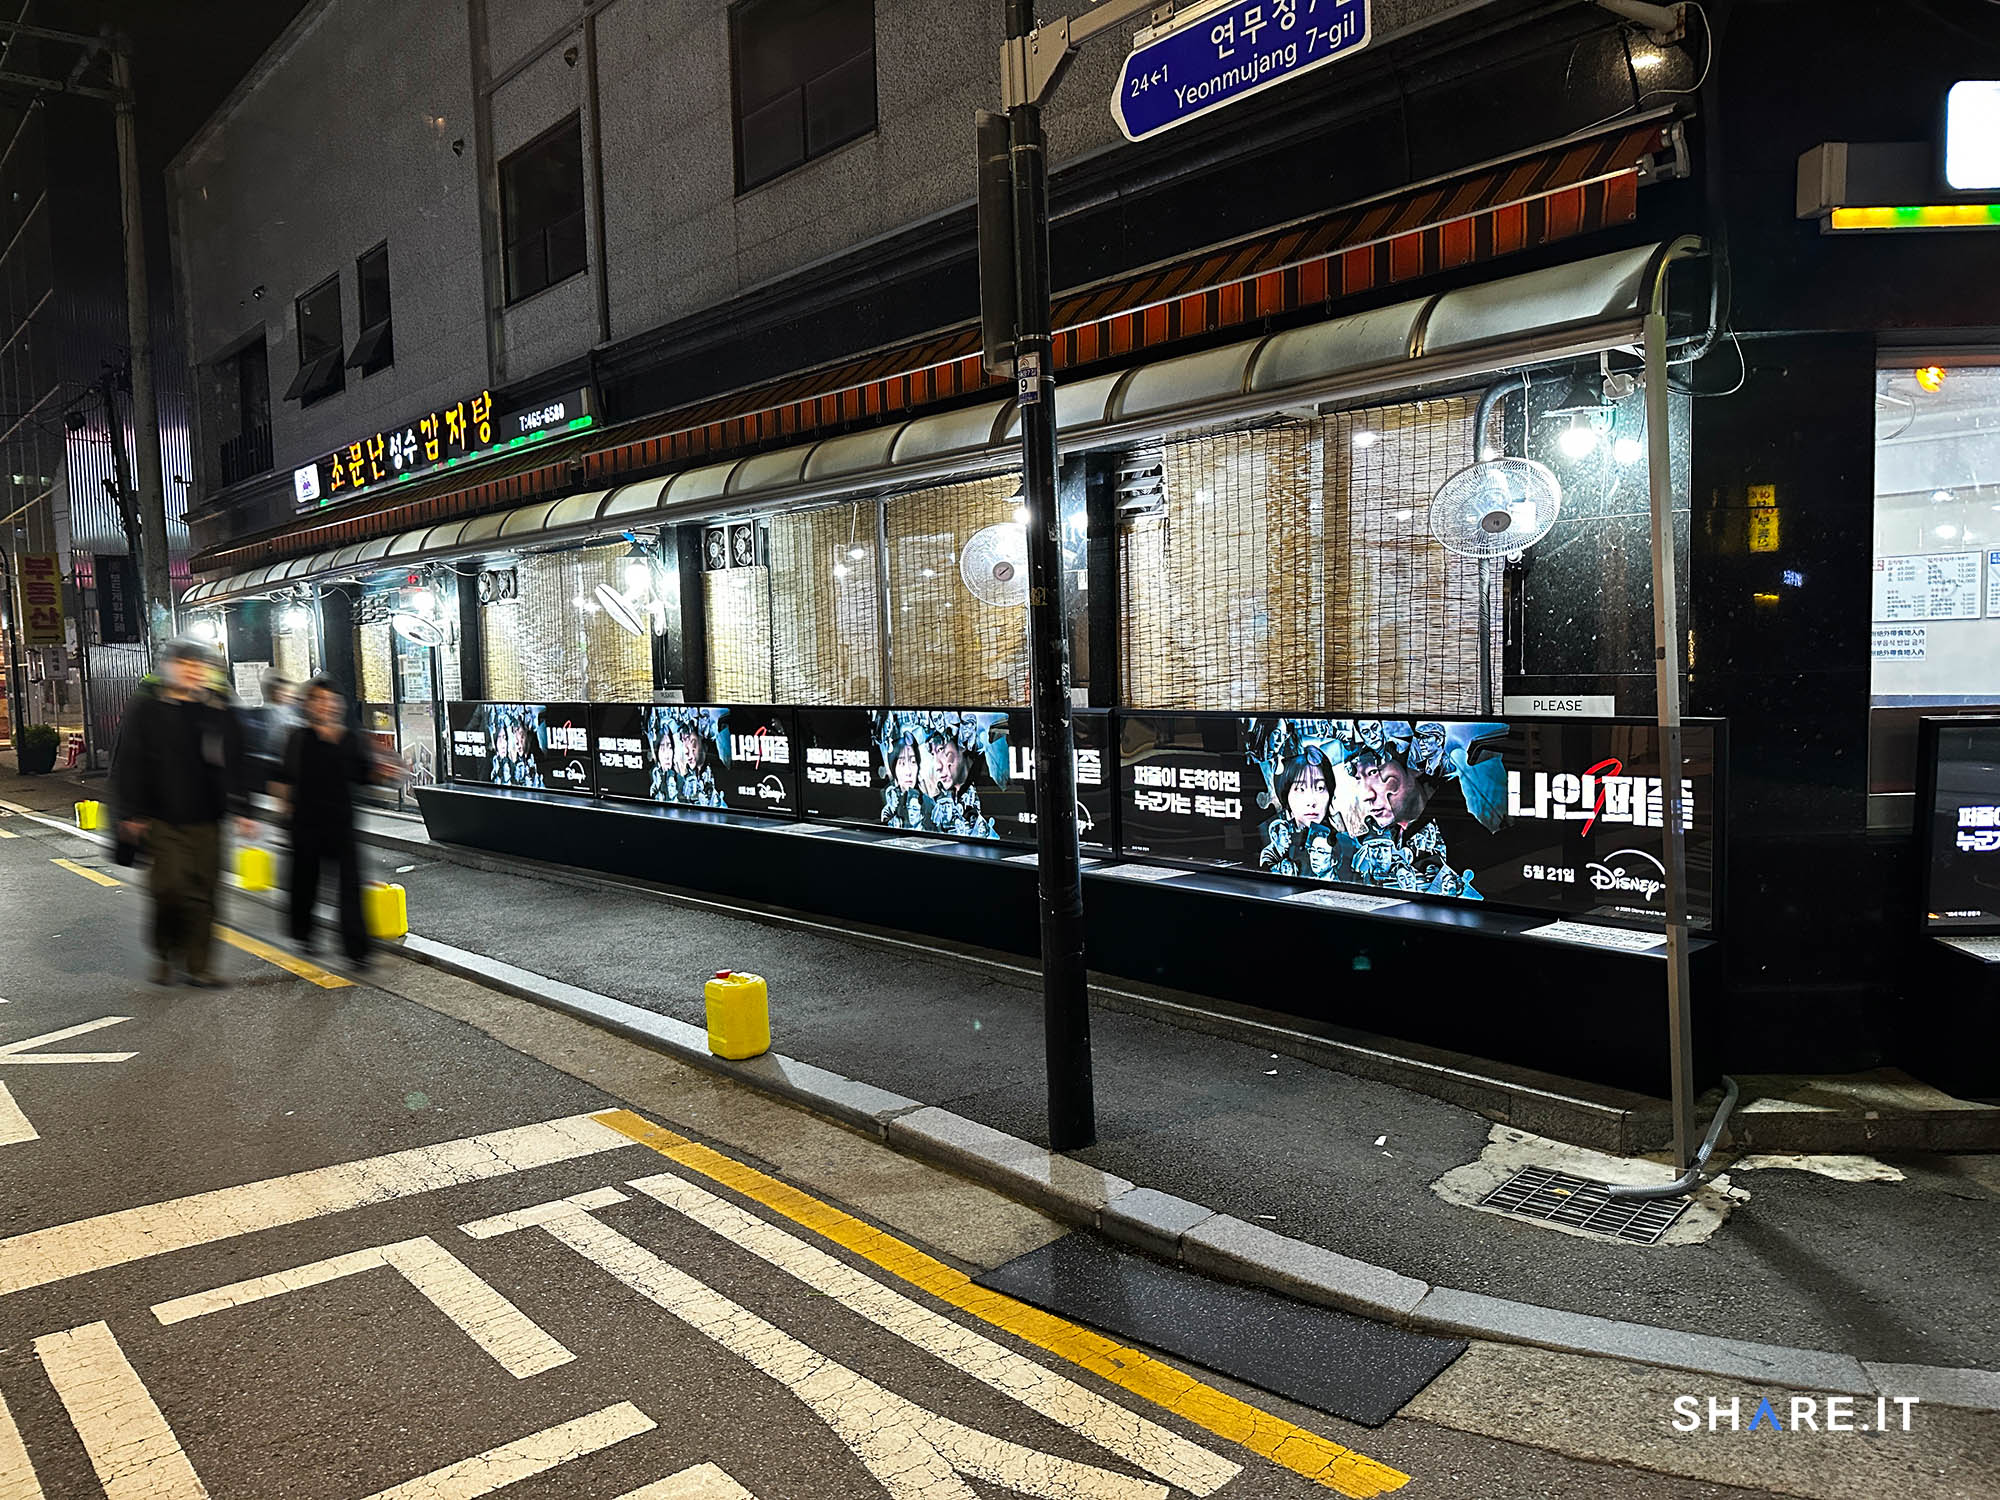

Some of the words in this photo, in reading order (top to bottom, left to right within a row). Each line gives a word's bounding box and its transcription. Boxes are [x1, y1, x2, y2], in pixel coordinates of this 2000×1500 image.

[1174, 42, 1297, 109] Yeonmujang
[1305, 10, 1355, 53] 7-gil
[1131, 73, 1149, 98] 24
[1021, 379, 1028, 392] 9
[331, 432, 386, 492] 소문난
[389, 427, 418, 470] 성수
[420, 390, 492, 461] 감자탕
[24, 556, 60, 631] 부동산
[1533, 700, 1582, 711] PLEASE
[1134, 766, 1176, 788] 퍼즐이
[1179, 768, 1240, 792] 도착하면
[1134, 790, 1191, 814] 누군가는
[1195, 795, 1242, 819] 죽는다
[1523, 865, 1545, 881] 5월
[1547, 867, 1575, 883] 21일
